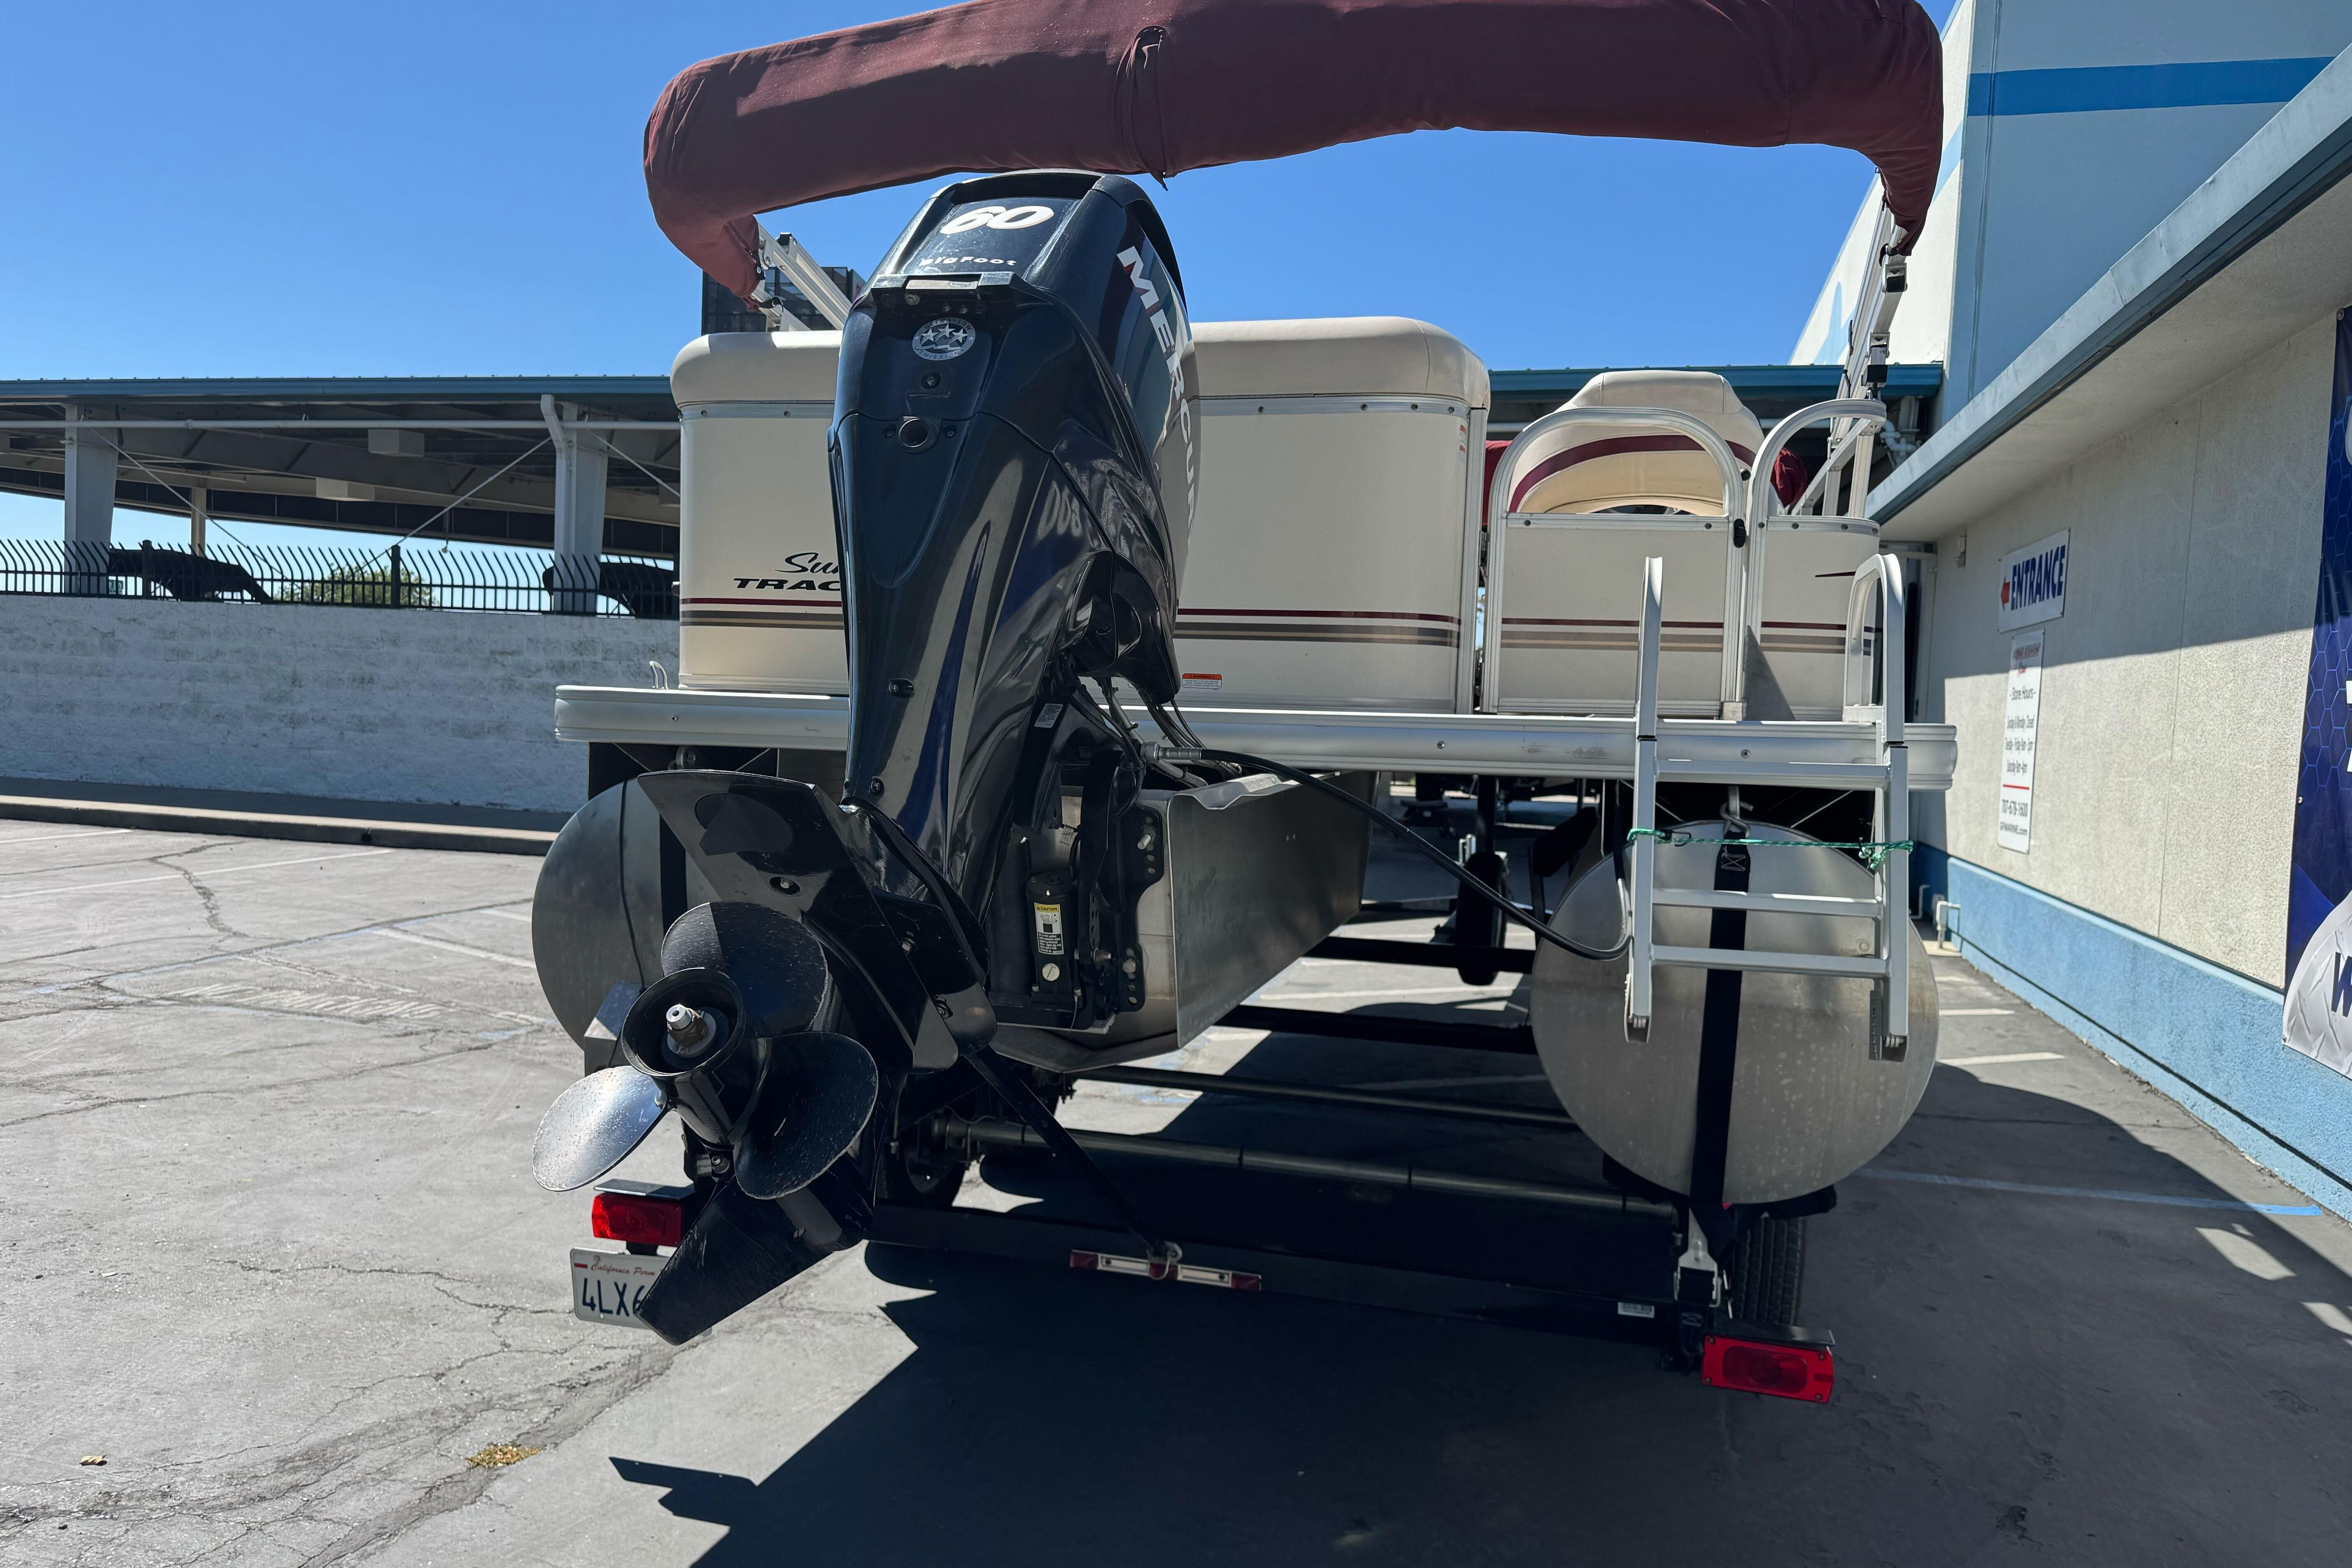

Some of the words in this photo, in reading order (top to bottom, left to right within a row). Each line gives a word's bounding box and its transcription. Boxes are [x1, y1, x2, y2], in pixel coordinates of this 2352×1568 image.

[940, 205, 1055, 235] 60
[2011, 544, 2066, 611] ENTRANCE
[591, 1262, 630, 1274] California
